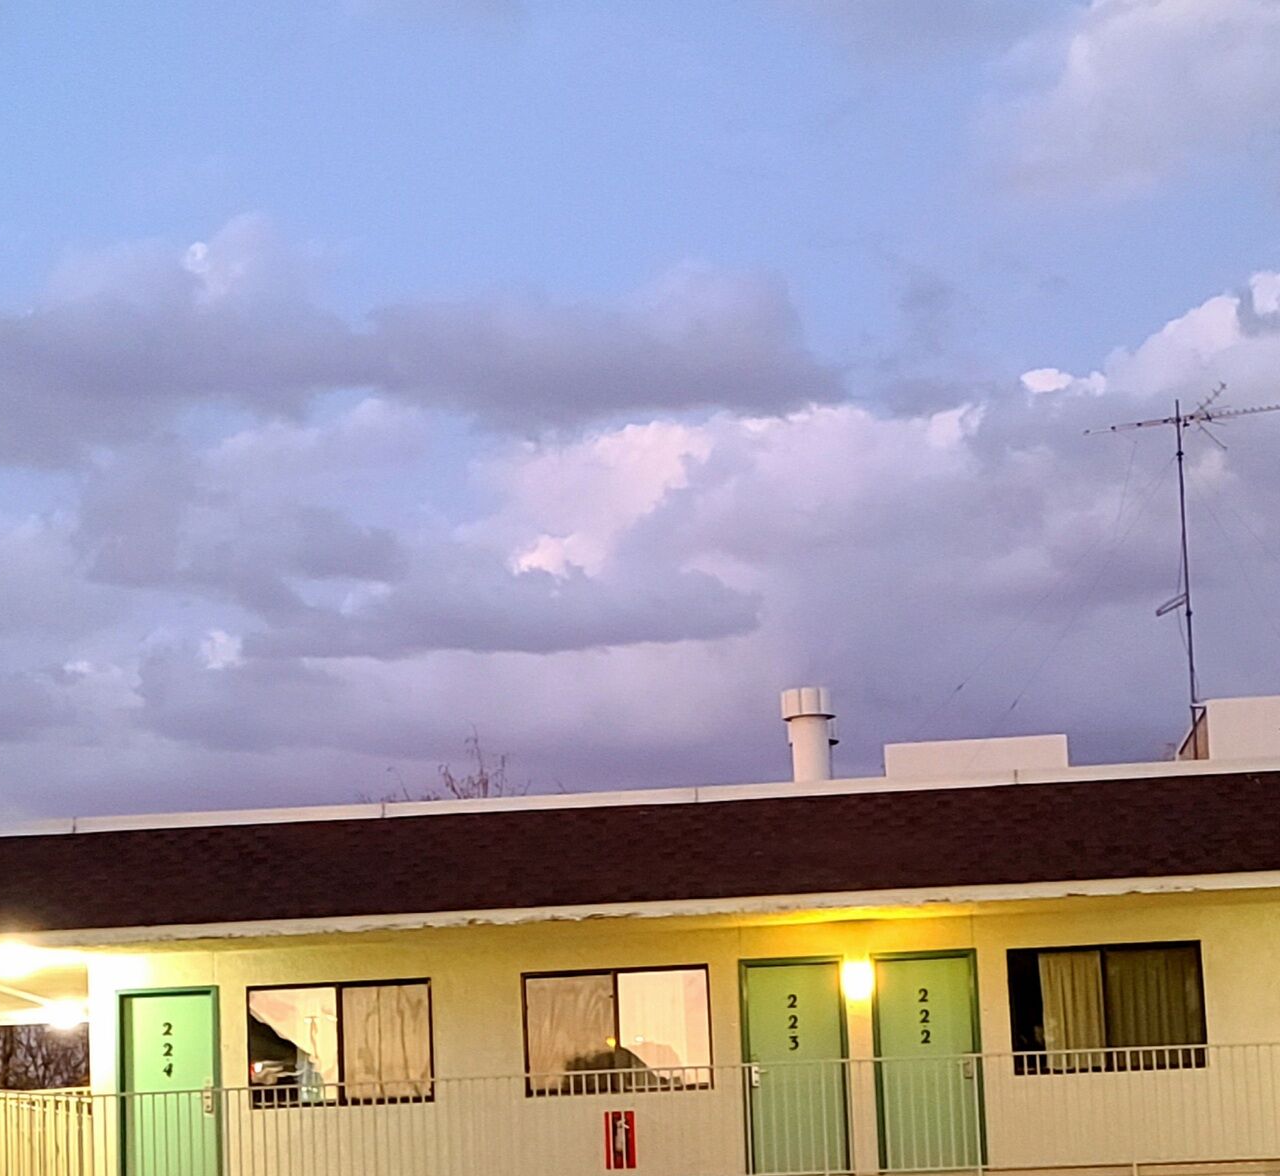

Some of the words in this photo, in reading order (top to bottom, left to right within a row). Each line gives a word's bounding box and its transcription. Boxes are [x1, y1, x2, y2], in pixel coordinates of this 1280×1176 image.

[787, 994, 799, 1051] 223
[919, 988, 931, 1044] 222
[162, 1022, 173, 1078] 224
